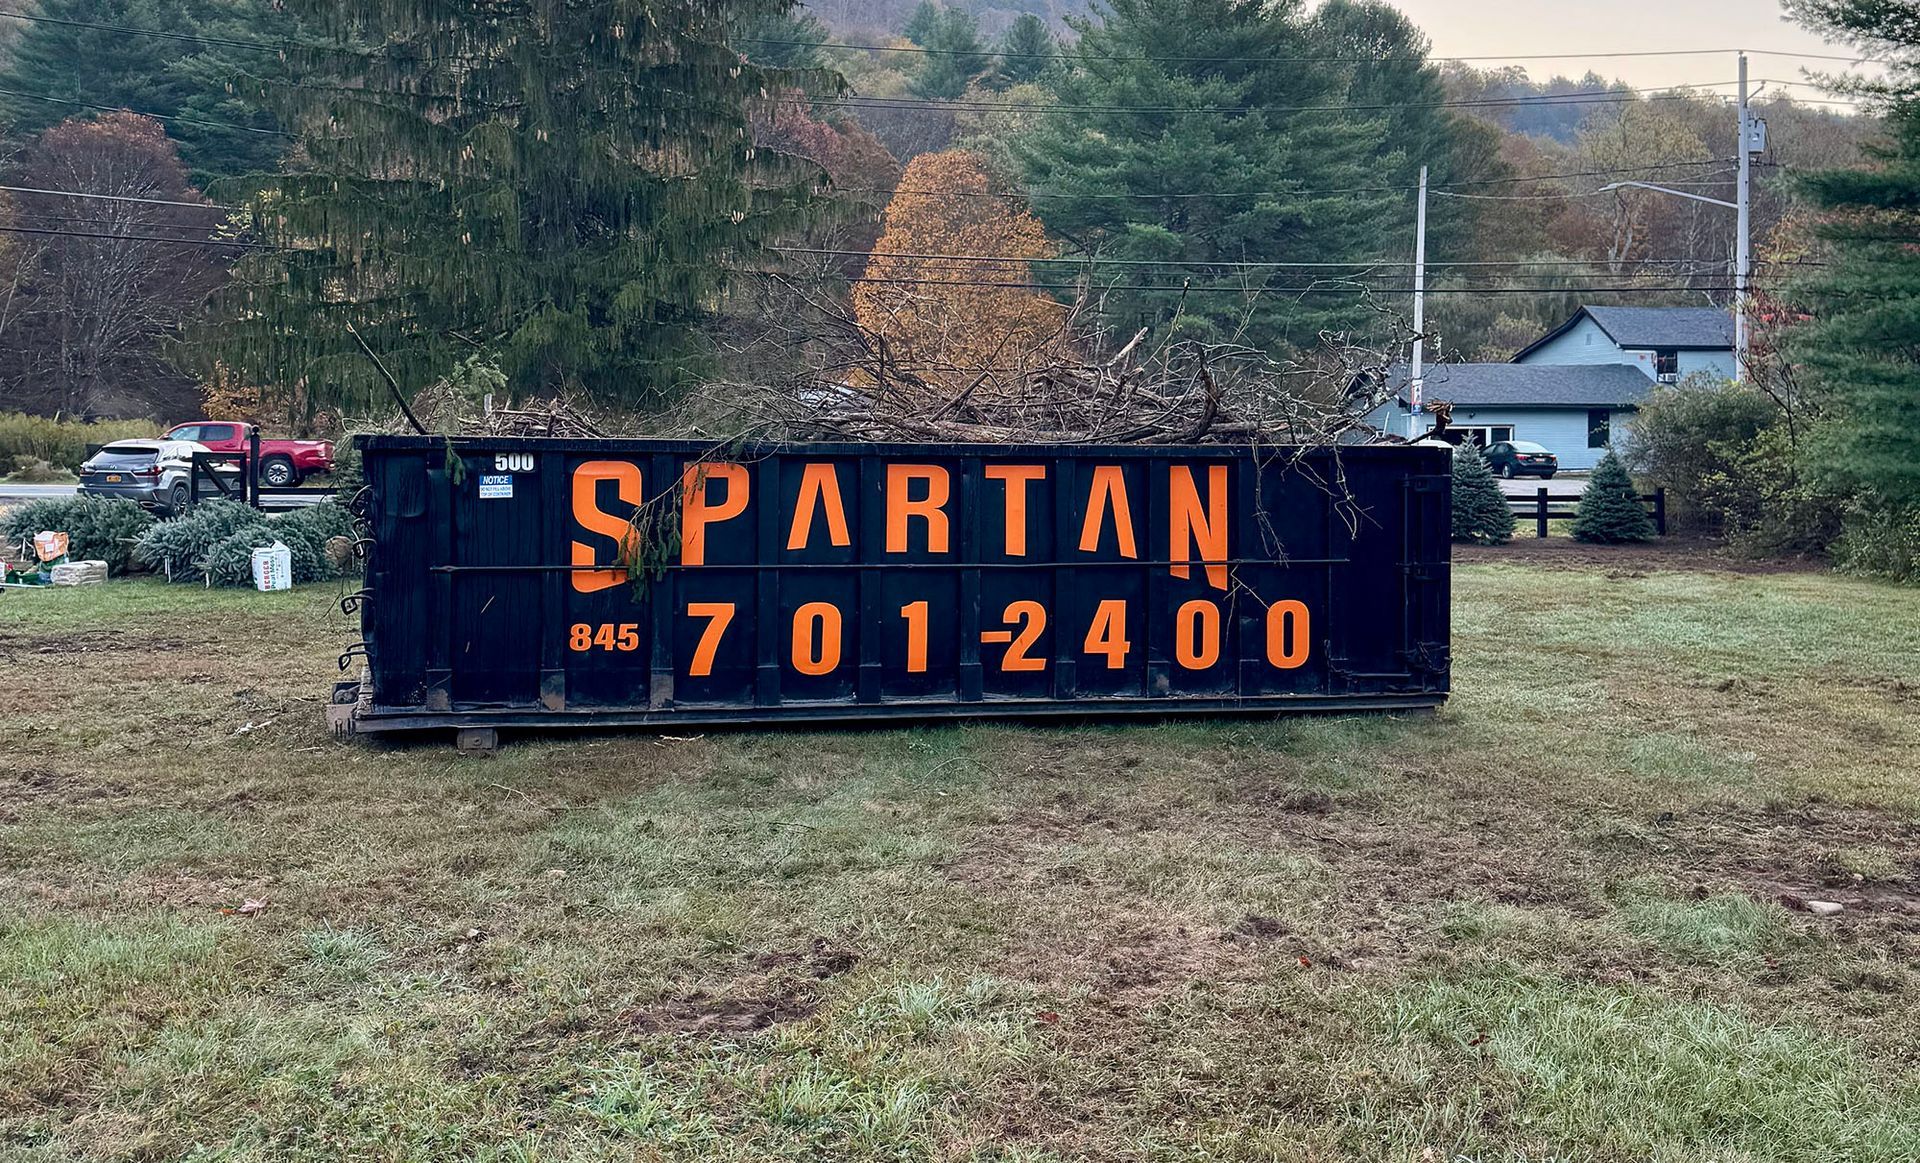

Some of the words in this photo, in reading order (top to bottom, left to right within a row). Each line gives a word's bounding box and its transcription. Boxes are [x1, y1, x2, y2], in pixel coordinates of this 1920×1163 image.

[482, 476, 508, 484] NOTICE
[495, 453, 534, 471] 500
[571, 461, 1228, 592] SPARTAN
[569, 623, 640, 651] 845
[687, 600, 1310, 676] 701-2400
